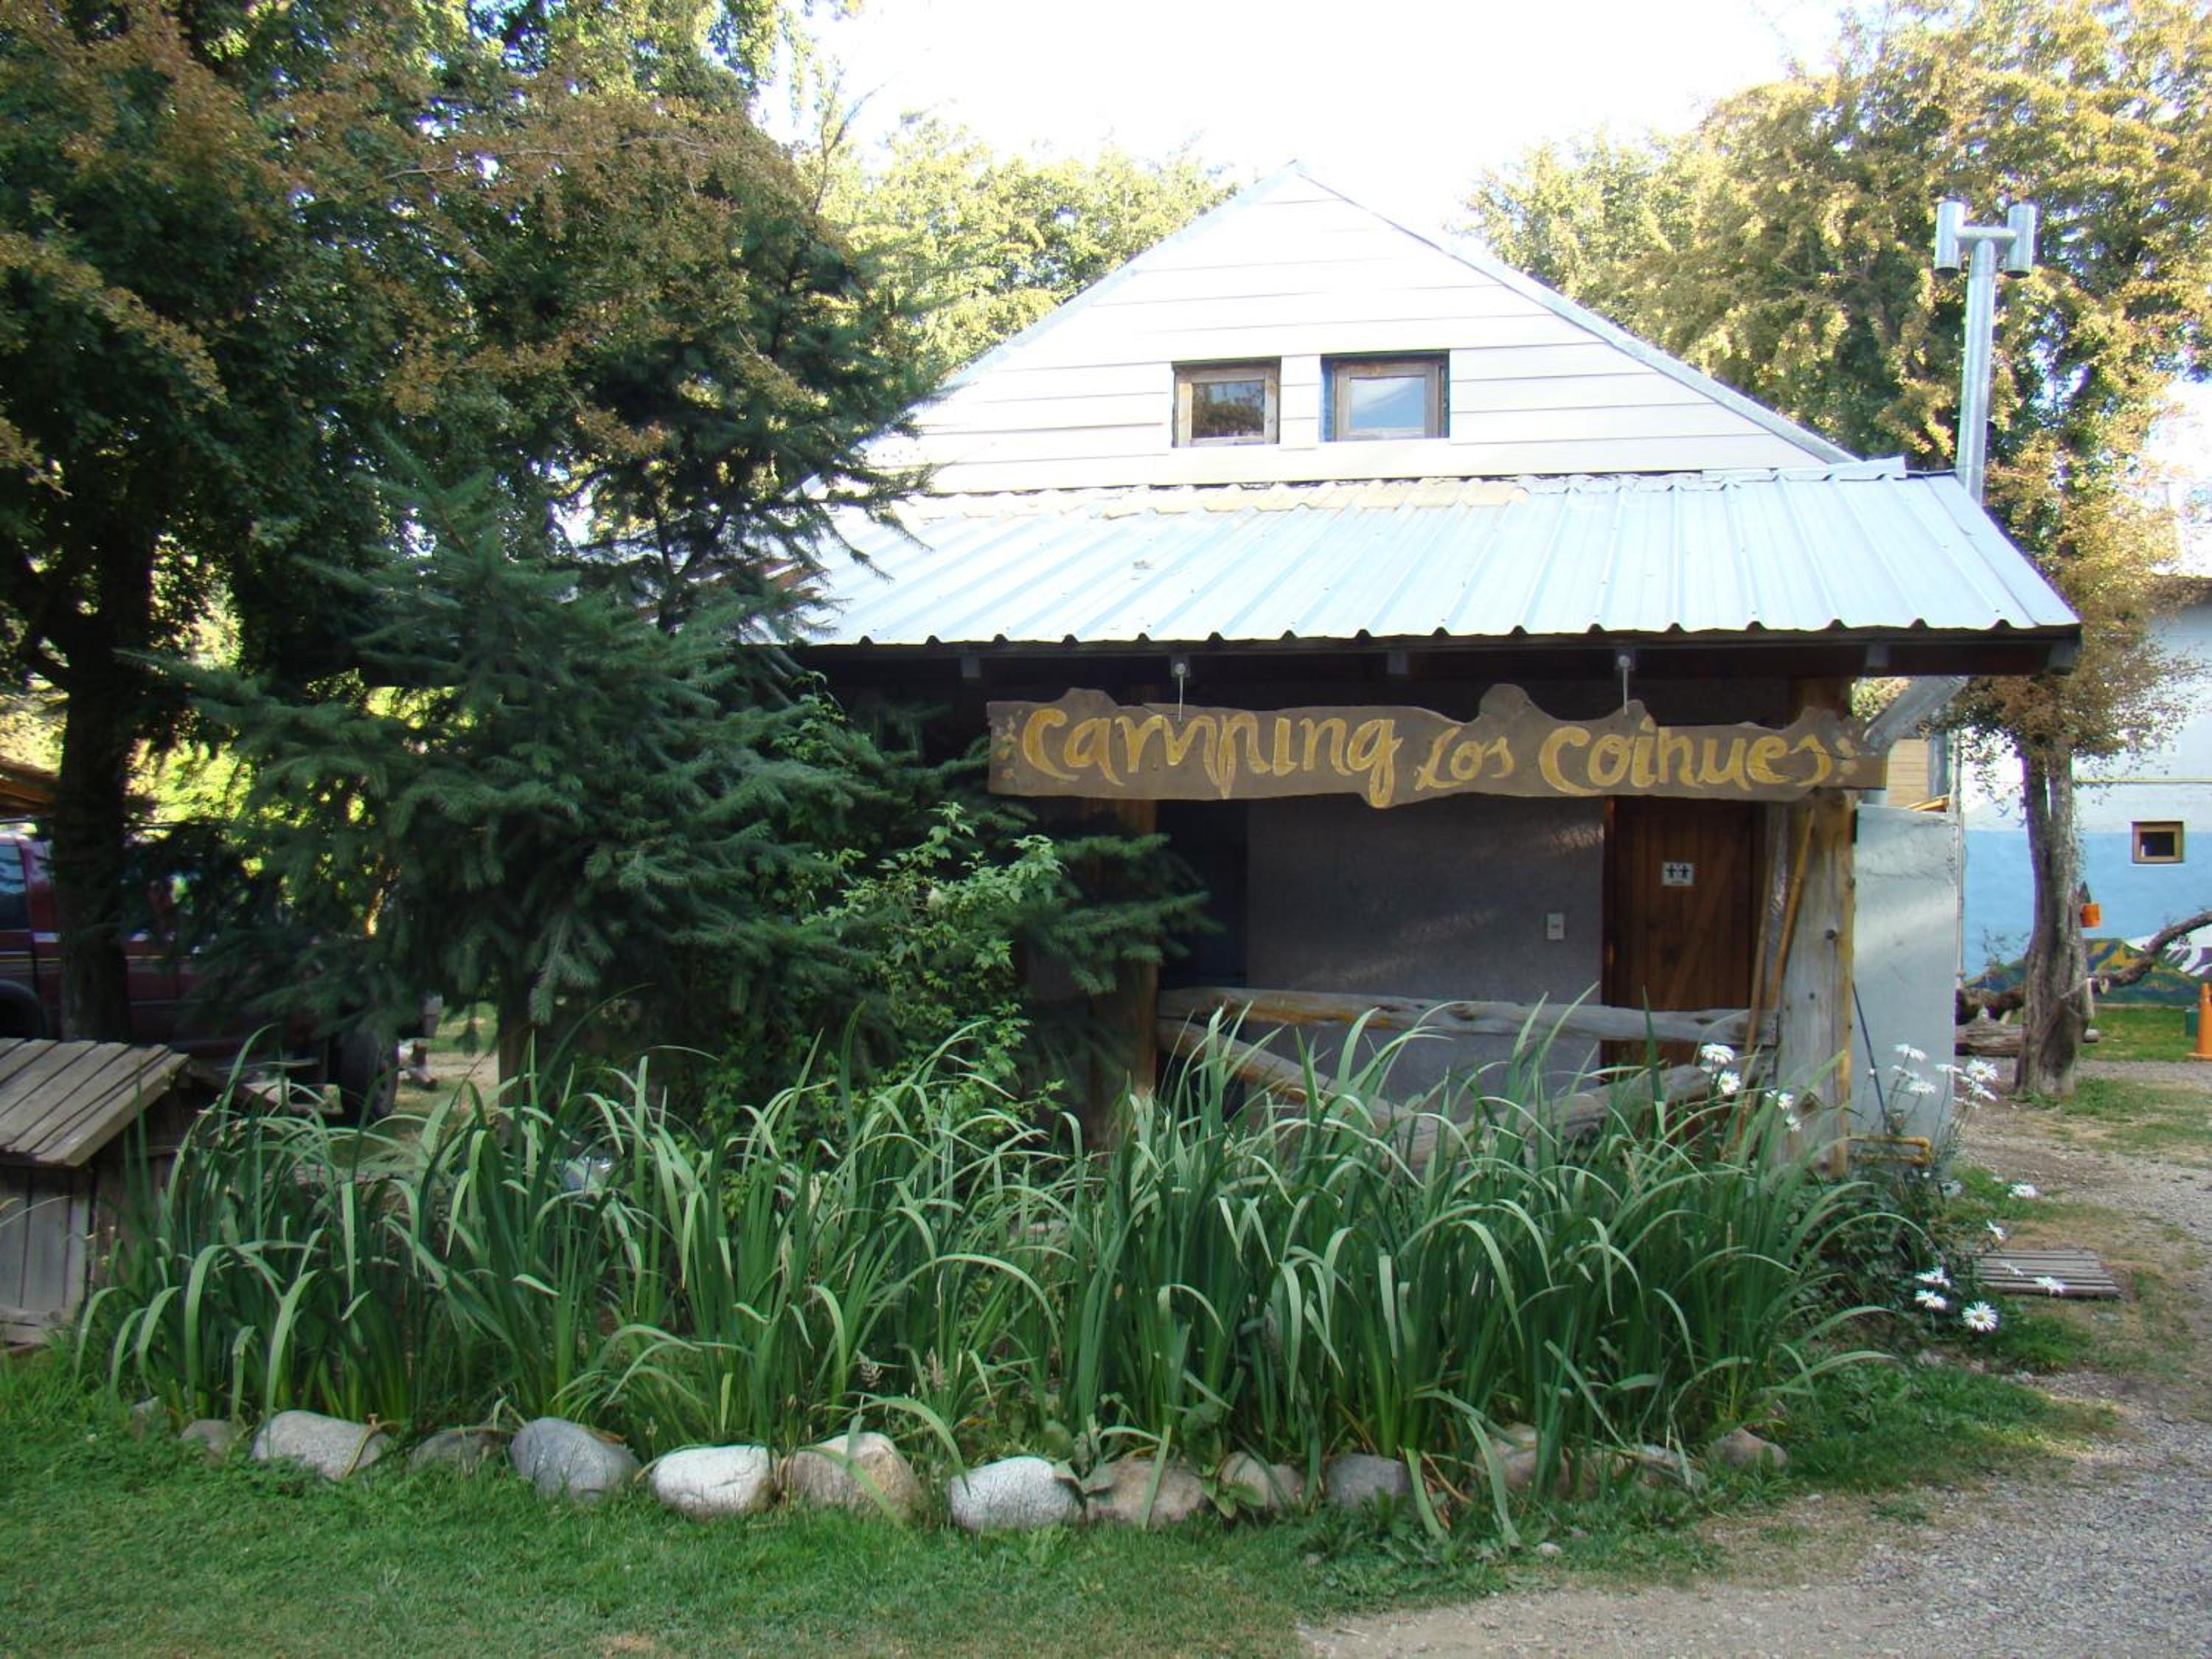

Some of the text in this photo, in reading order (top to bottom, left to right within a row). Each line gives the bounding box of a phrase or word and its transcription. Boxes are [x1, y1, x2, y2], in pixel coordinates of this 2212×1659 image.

[1022, 707, 1832, 808] Camping Los Coihues
